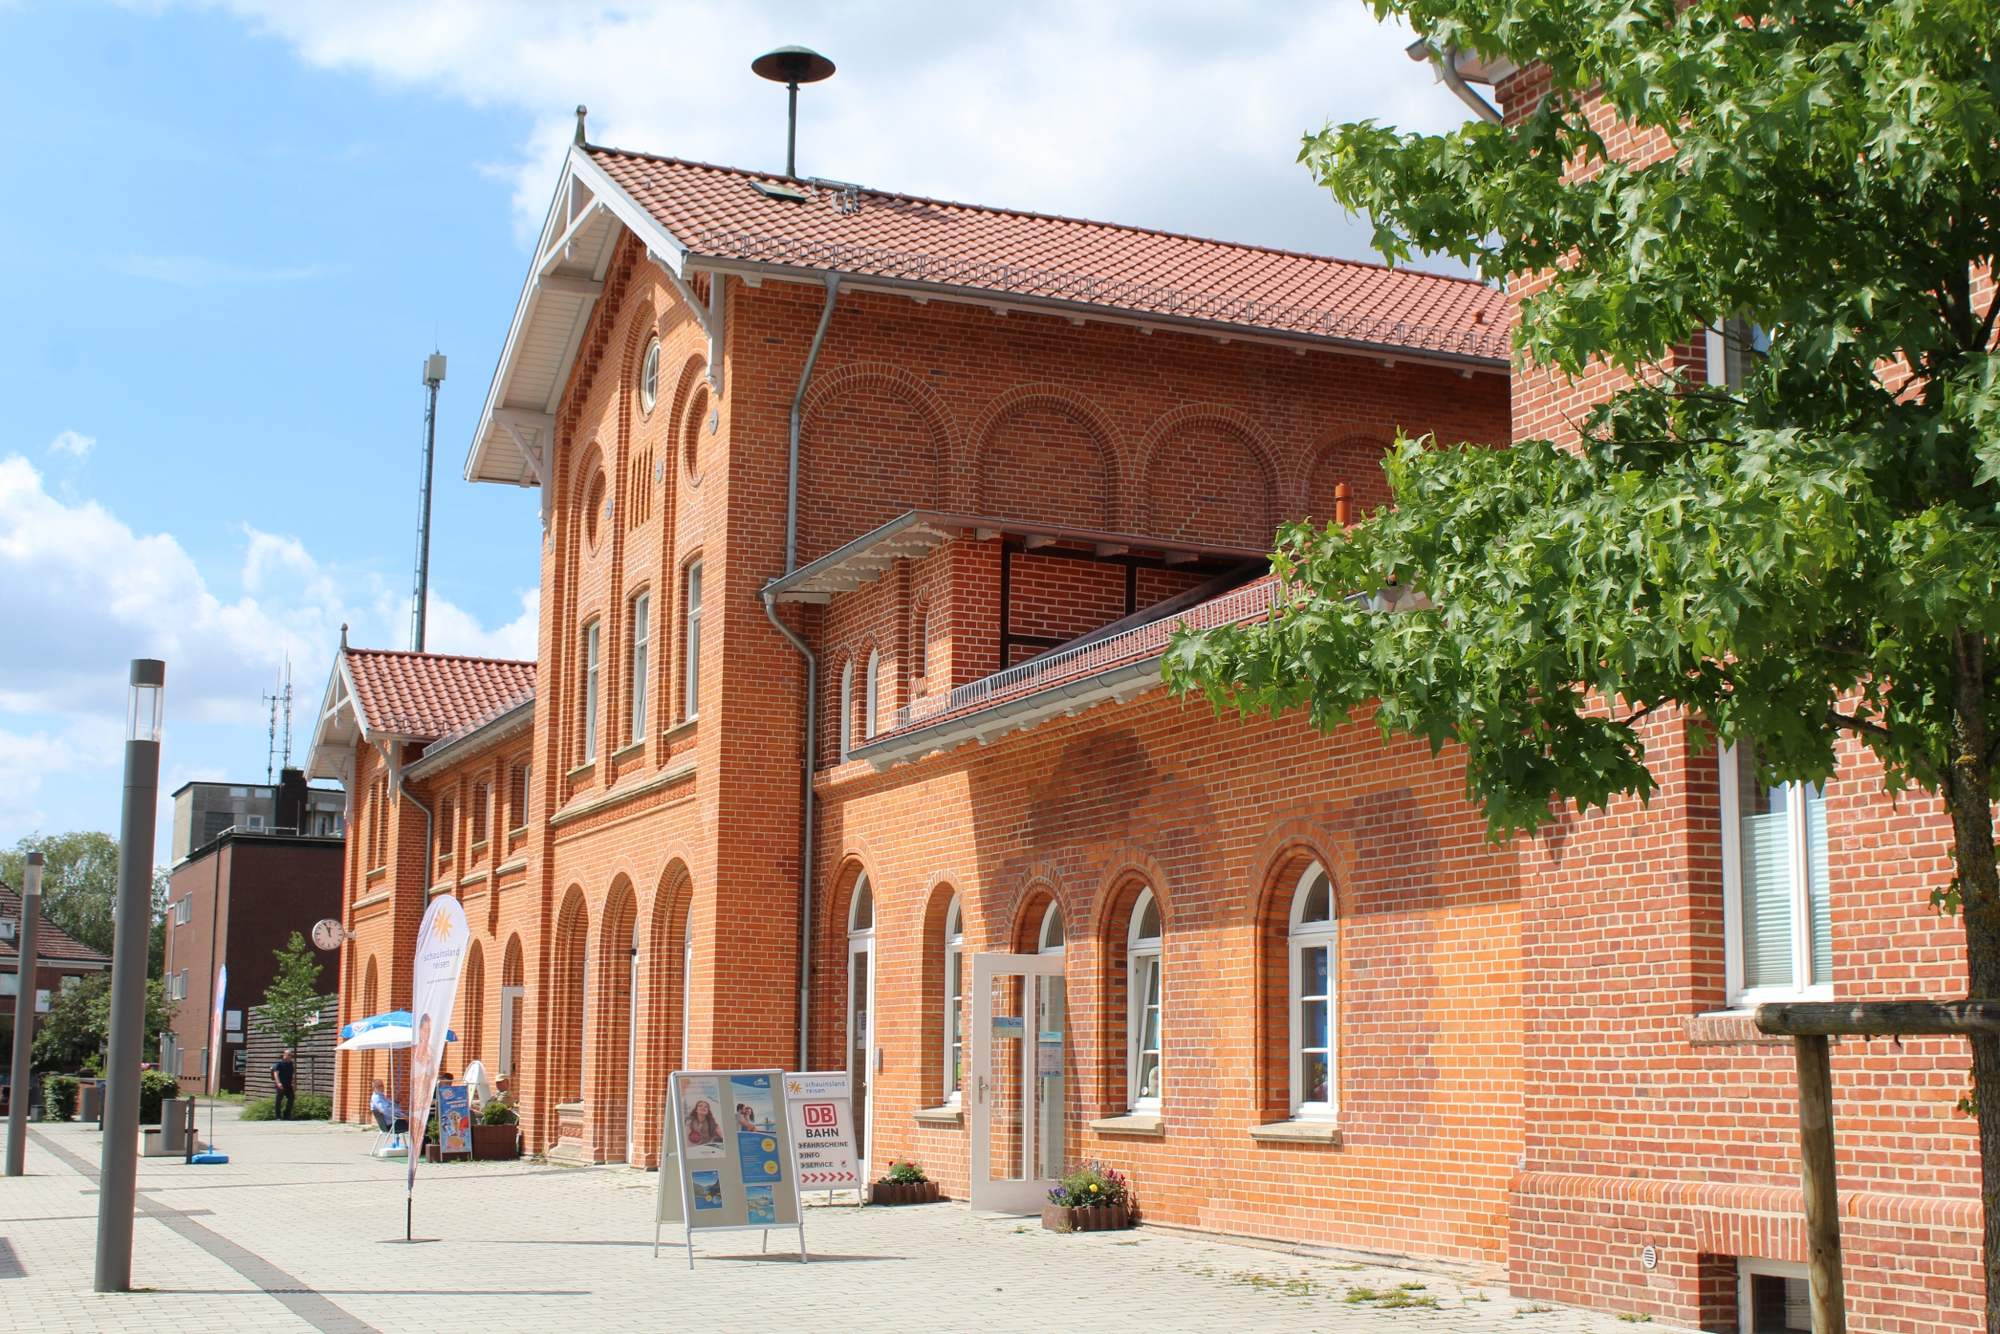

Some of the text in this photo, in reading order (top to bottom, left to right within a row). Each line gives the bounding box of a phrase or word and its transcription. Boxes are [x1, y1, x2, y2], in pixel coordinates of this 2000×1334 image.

[424, 947, 460, 961] schauinsland
[432, 960, 450, 969] reisen
[807, 1107, 833, 1123] DB
[806, 1128, 839, 1138] BAHN
